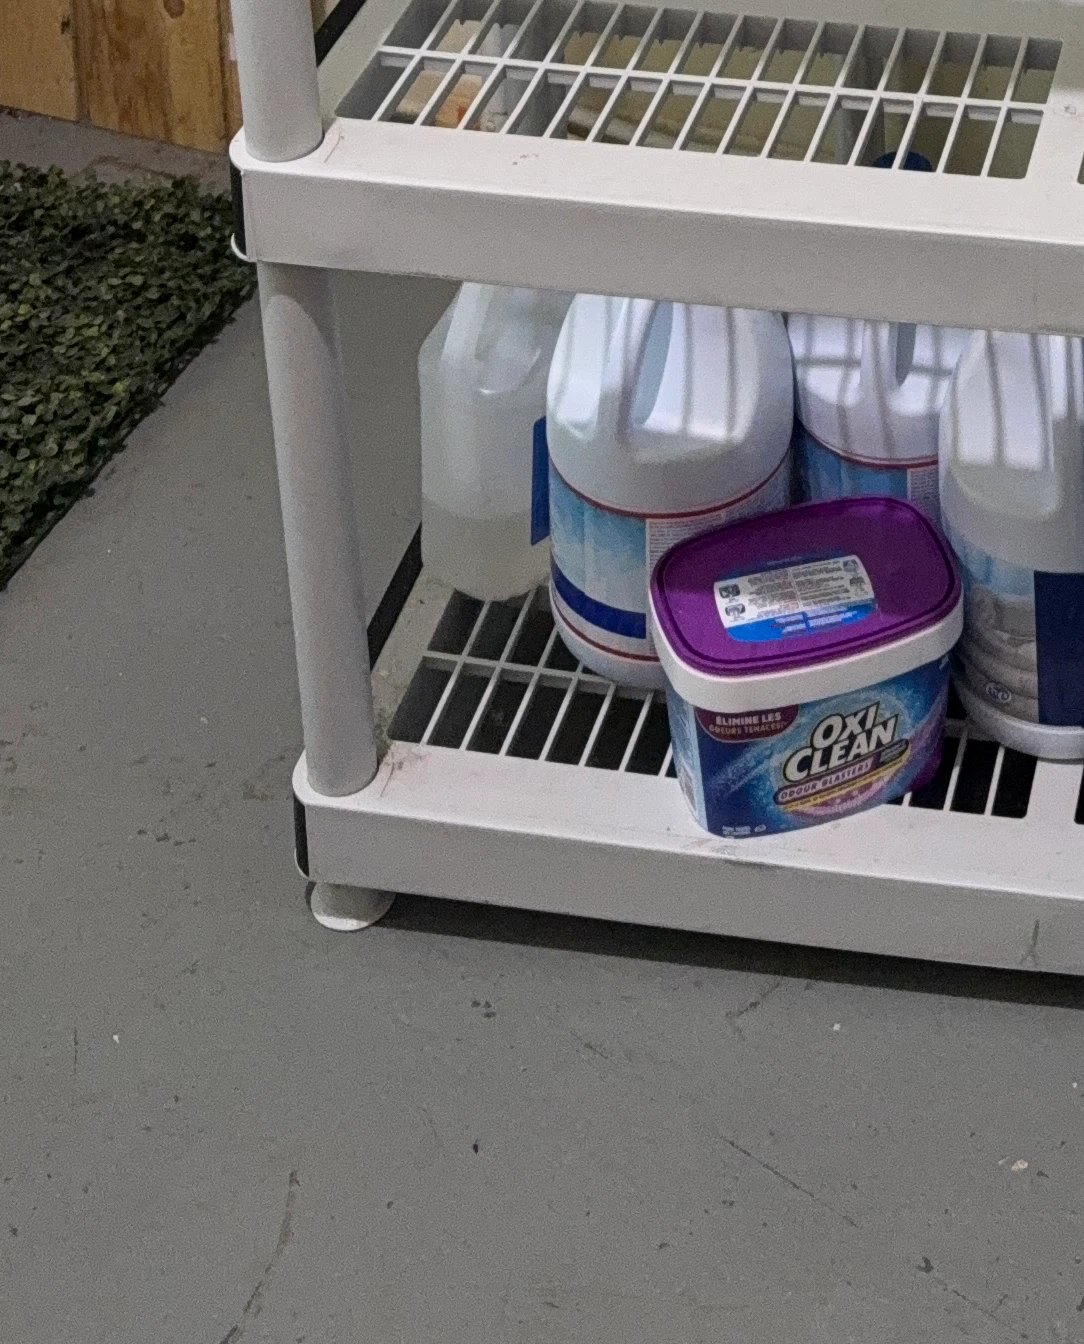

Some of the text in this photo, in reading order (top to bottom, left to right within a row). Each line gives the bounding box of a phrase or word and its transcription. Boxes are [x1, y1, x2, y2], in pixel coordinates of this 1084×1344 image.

[715, 711, 782, 726] ÉLIMINE LES
[813, 702, 879, 749] OXI
[785, 715, 897, 781] CLEAN
[779, 782, 818, 801] ODOUR
[820, 760, 871, 789] BLASTERS
